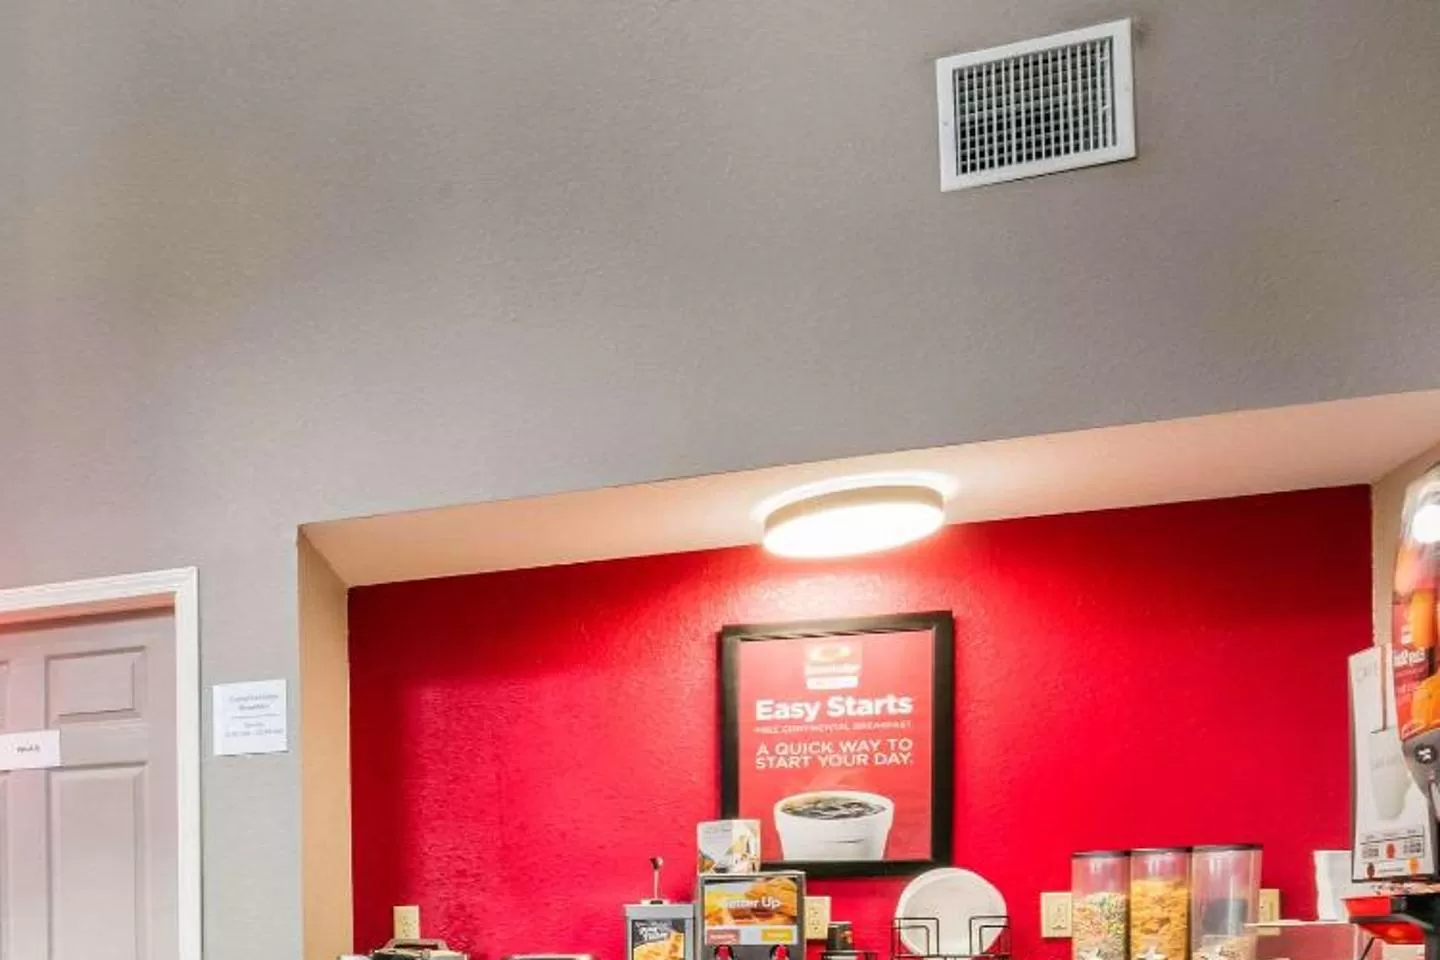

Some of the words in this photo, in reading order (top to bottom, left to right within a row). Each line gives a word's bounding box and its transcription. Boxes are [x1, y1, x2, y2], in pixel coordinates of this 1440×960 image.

[755, 698, 821, 722] Easy
[826, 694, 913, 717] Starts
[756, 743, 769, 756] A
[775, 741, 834, 756] QUICK
[839, 739, 881, 753] WAY
[887, 737, 913, 752] TO
[755, 755, 812, 770] START
[818, 754, 869, 768] YOUR
[761, 895, 781, 909] Up
